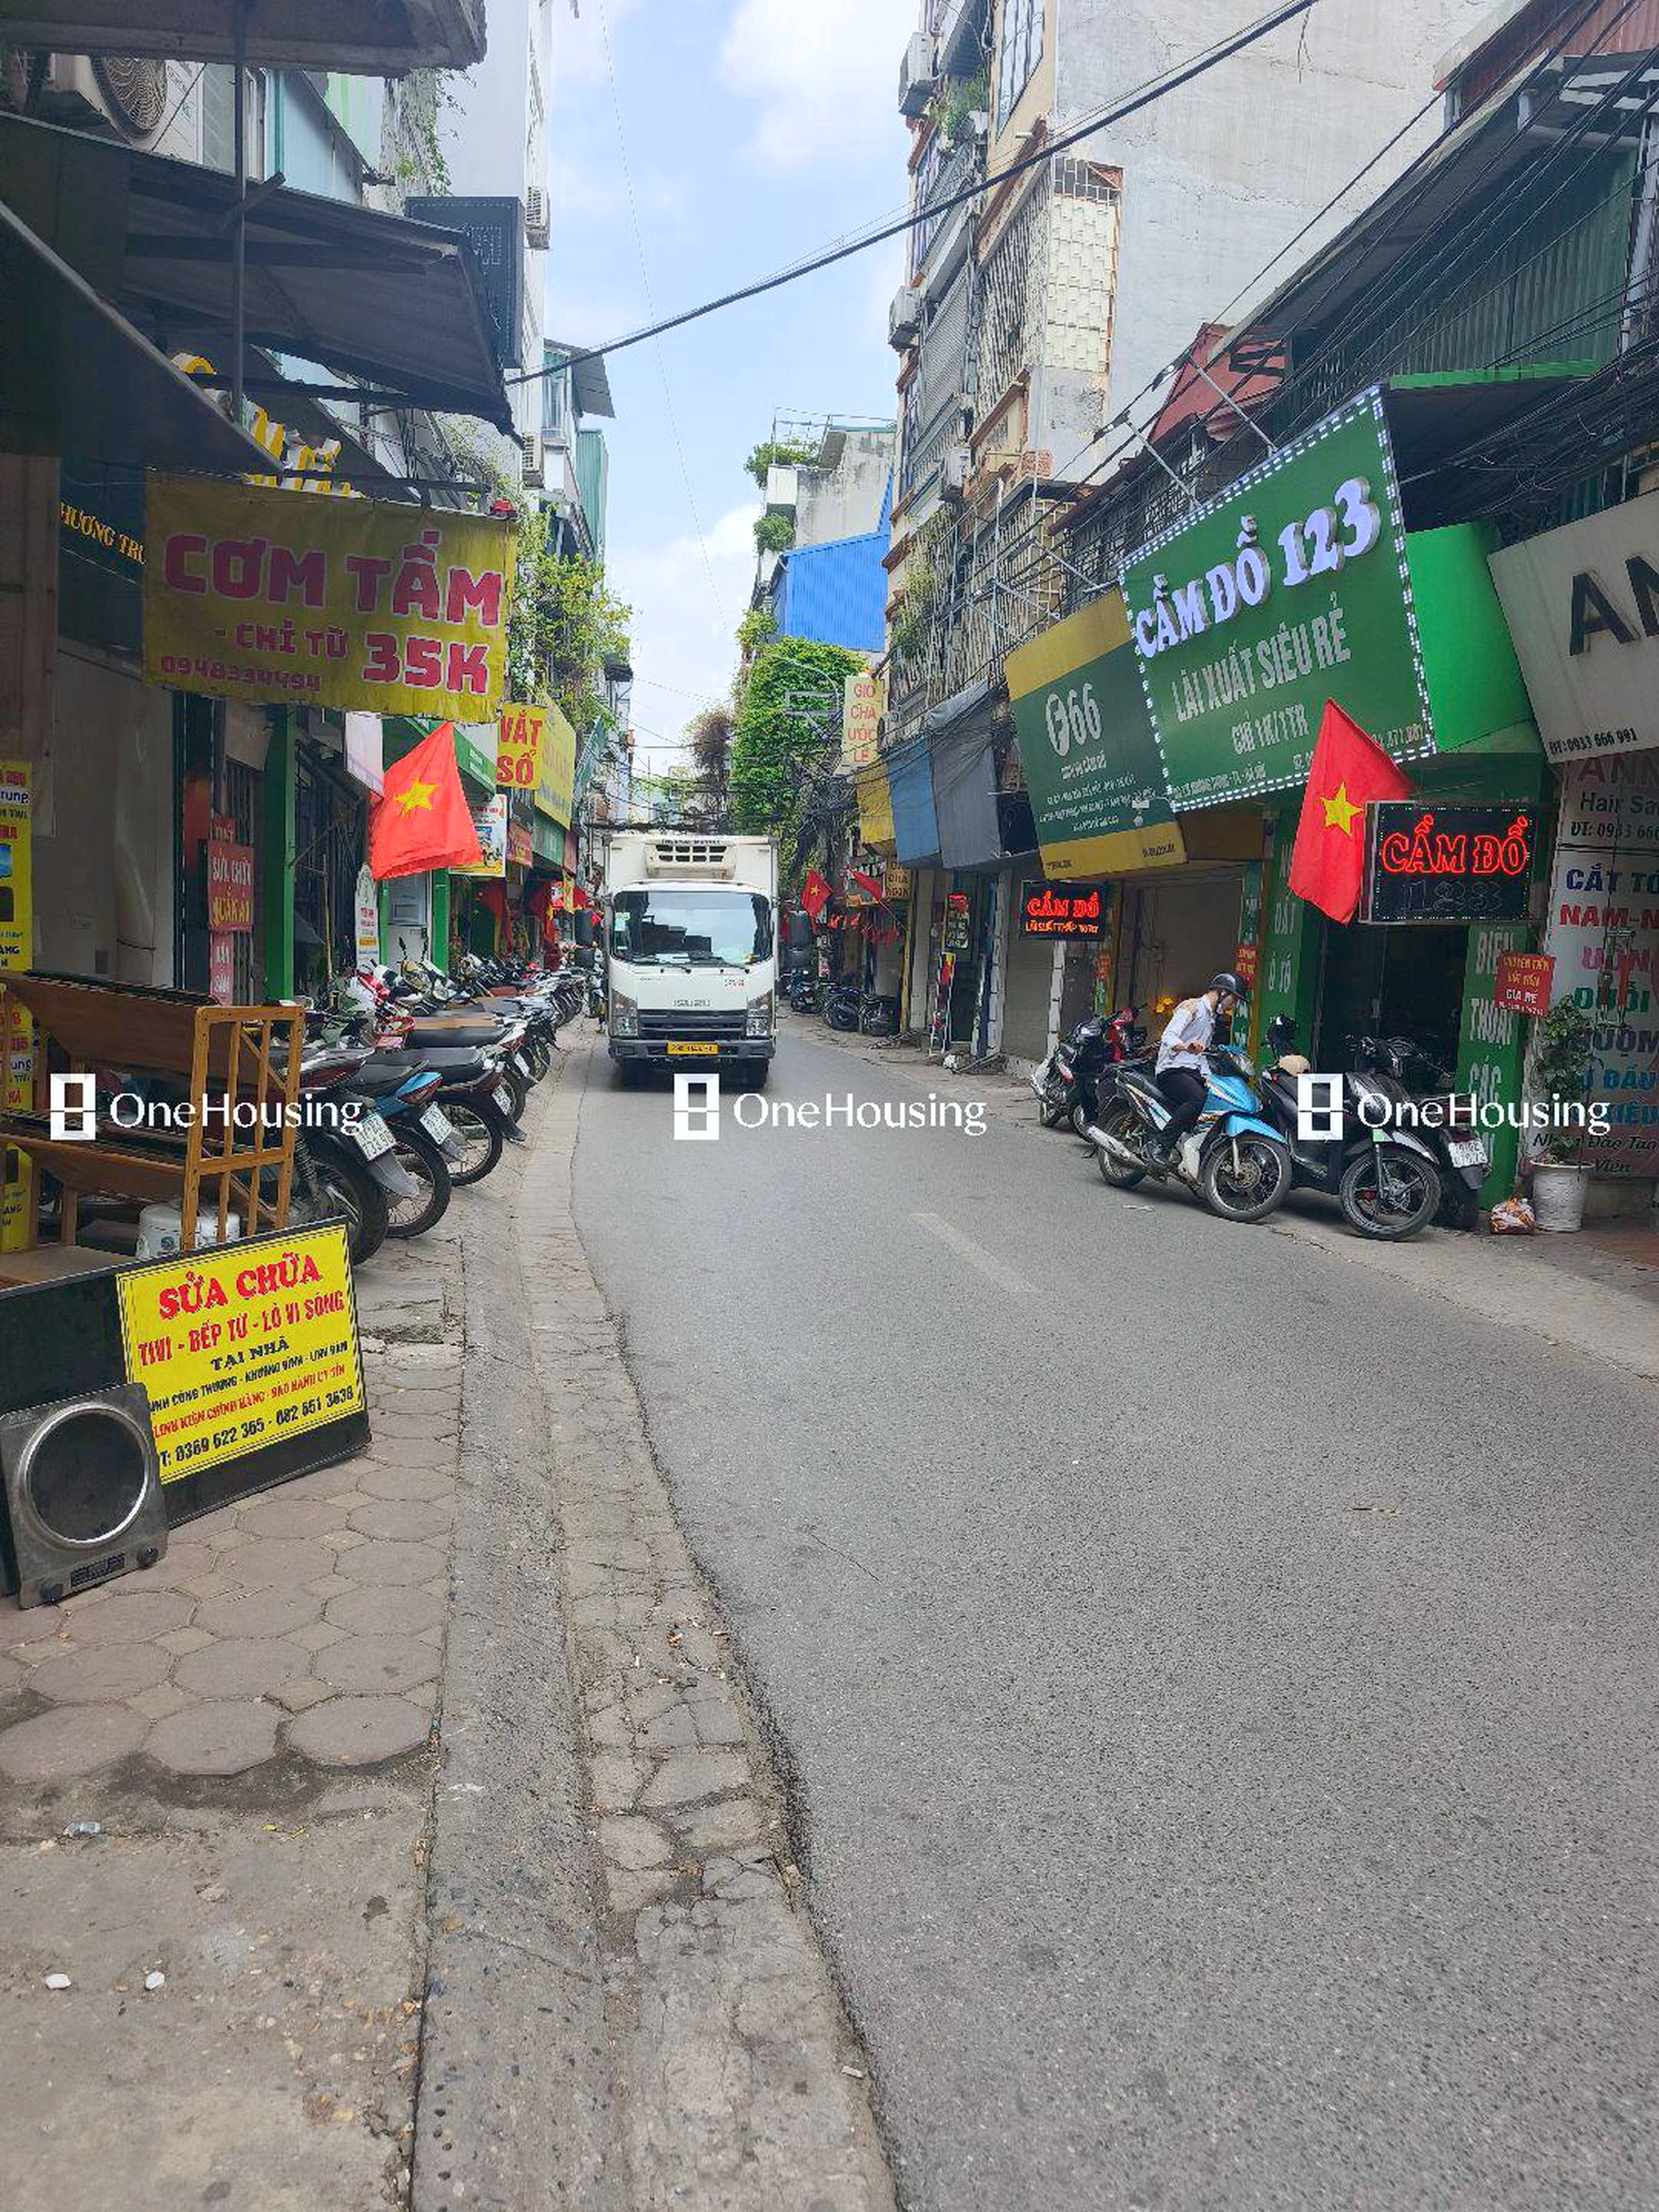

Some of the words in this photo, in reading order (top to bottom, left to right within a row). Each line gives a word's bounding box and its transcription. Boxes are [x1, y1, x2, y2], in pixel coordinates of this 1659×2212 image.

[163, 534, 326, 608] CƠM
[345, 529, 503, 627] TẤM
[1136, 574, 1211, 658] CẦM
[1277, 475, 1381, 586] 123
[363, 631, 491, 695] 35K
[1257, 622, 1313, 689] SIÊU
[1312, 591, 1352, 669] RẺ
[1580, 791, 1623, 813] Hair
[1382, 814, 1466, 873] CẦM
[159, 1271, 229, 1320] SỬA
[236, 1252, 323, 1300] CHỮA
[189, 1319, 222, 1352] BẾP
[262, 1302, 282, 1331] LÒ
[285, 1302, 300, 1324] VI
[304, 1290, 345, 1320] SÓNG
[210, 1351, 244, 1371] TẠI
[249, 1335, 289, 1360] NHÀ
[160, 1450, 172, 1467] T:
[174, 1436, 210, 1461] 0369
[212, 1426, 238, 1449] 622
[240, 1417, 265, 1439] 365
[275, 1404, 299, 1425] 082
